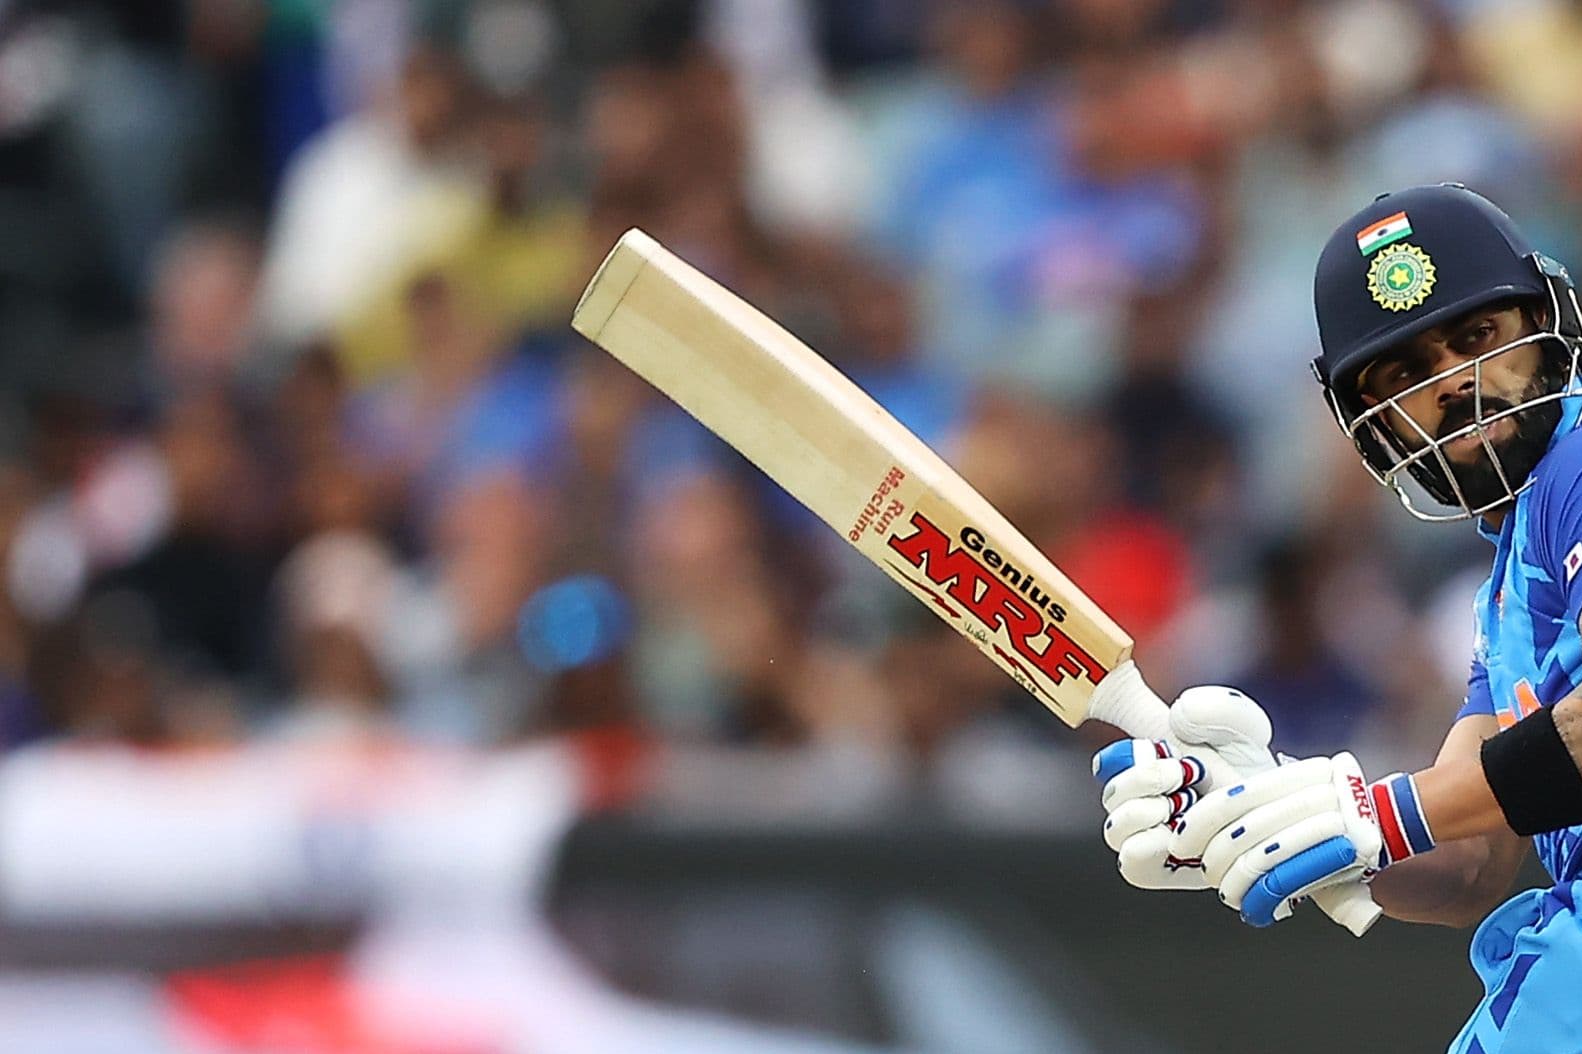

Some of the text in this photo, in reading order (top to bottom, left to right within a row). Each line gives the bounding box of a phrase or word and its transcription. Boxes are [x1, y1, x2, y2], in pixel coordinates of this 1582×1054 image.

[847, 465, 905, 542] Machine
[873, 499, 905, 536] Run
[886, 510, 1108, 687] MRF
[960, 526, 1068, 624] Genius
